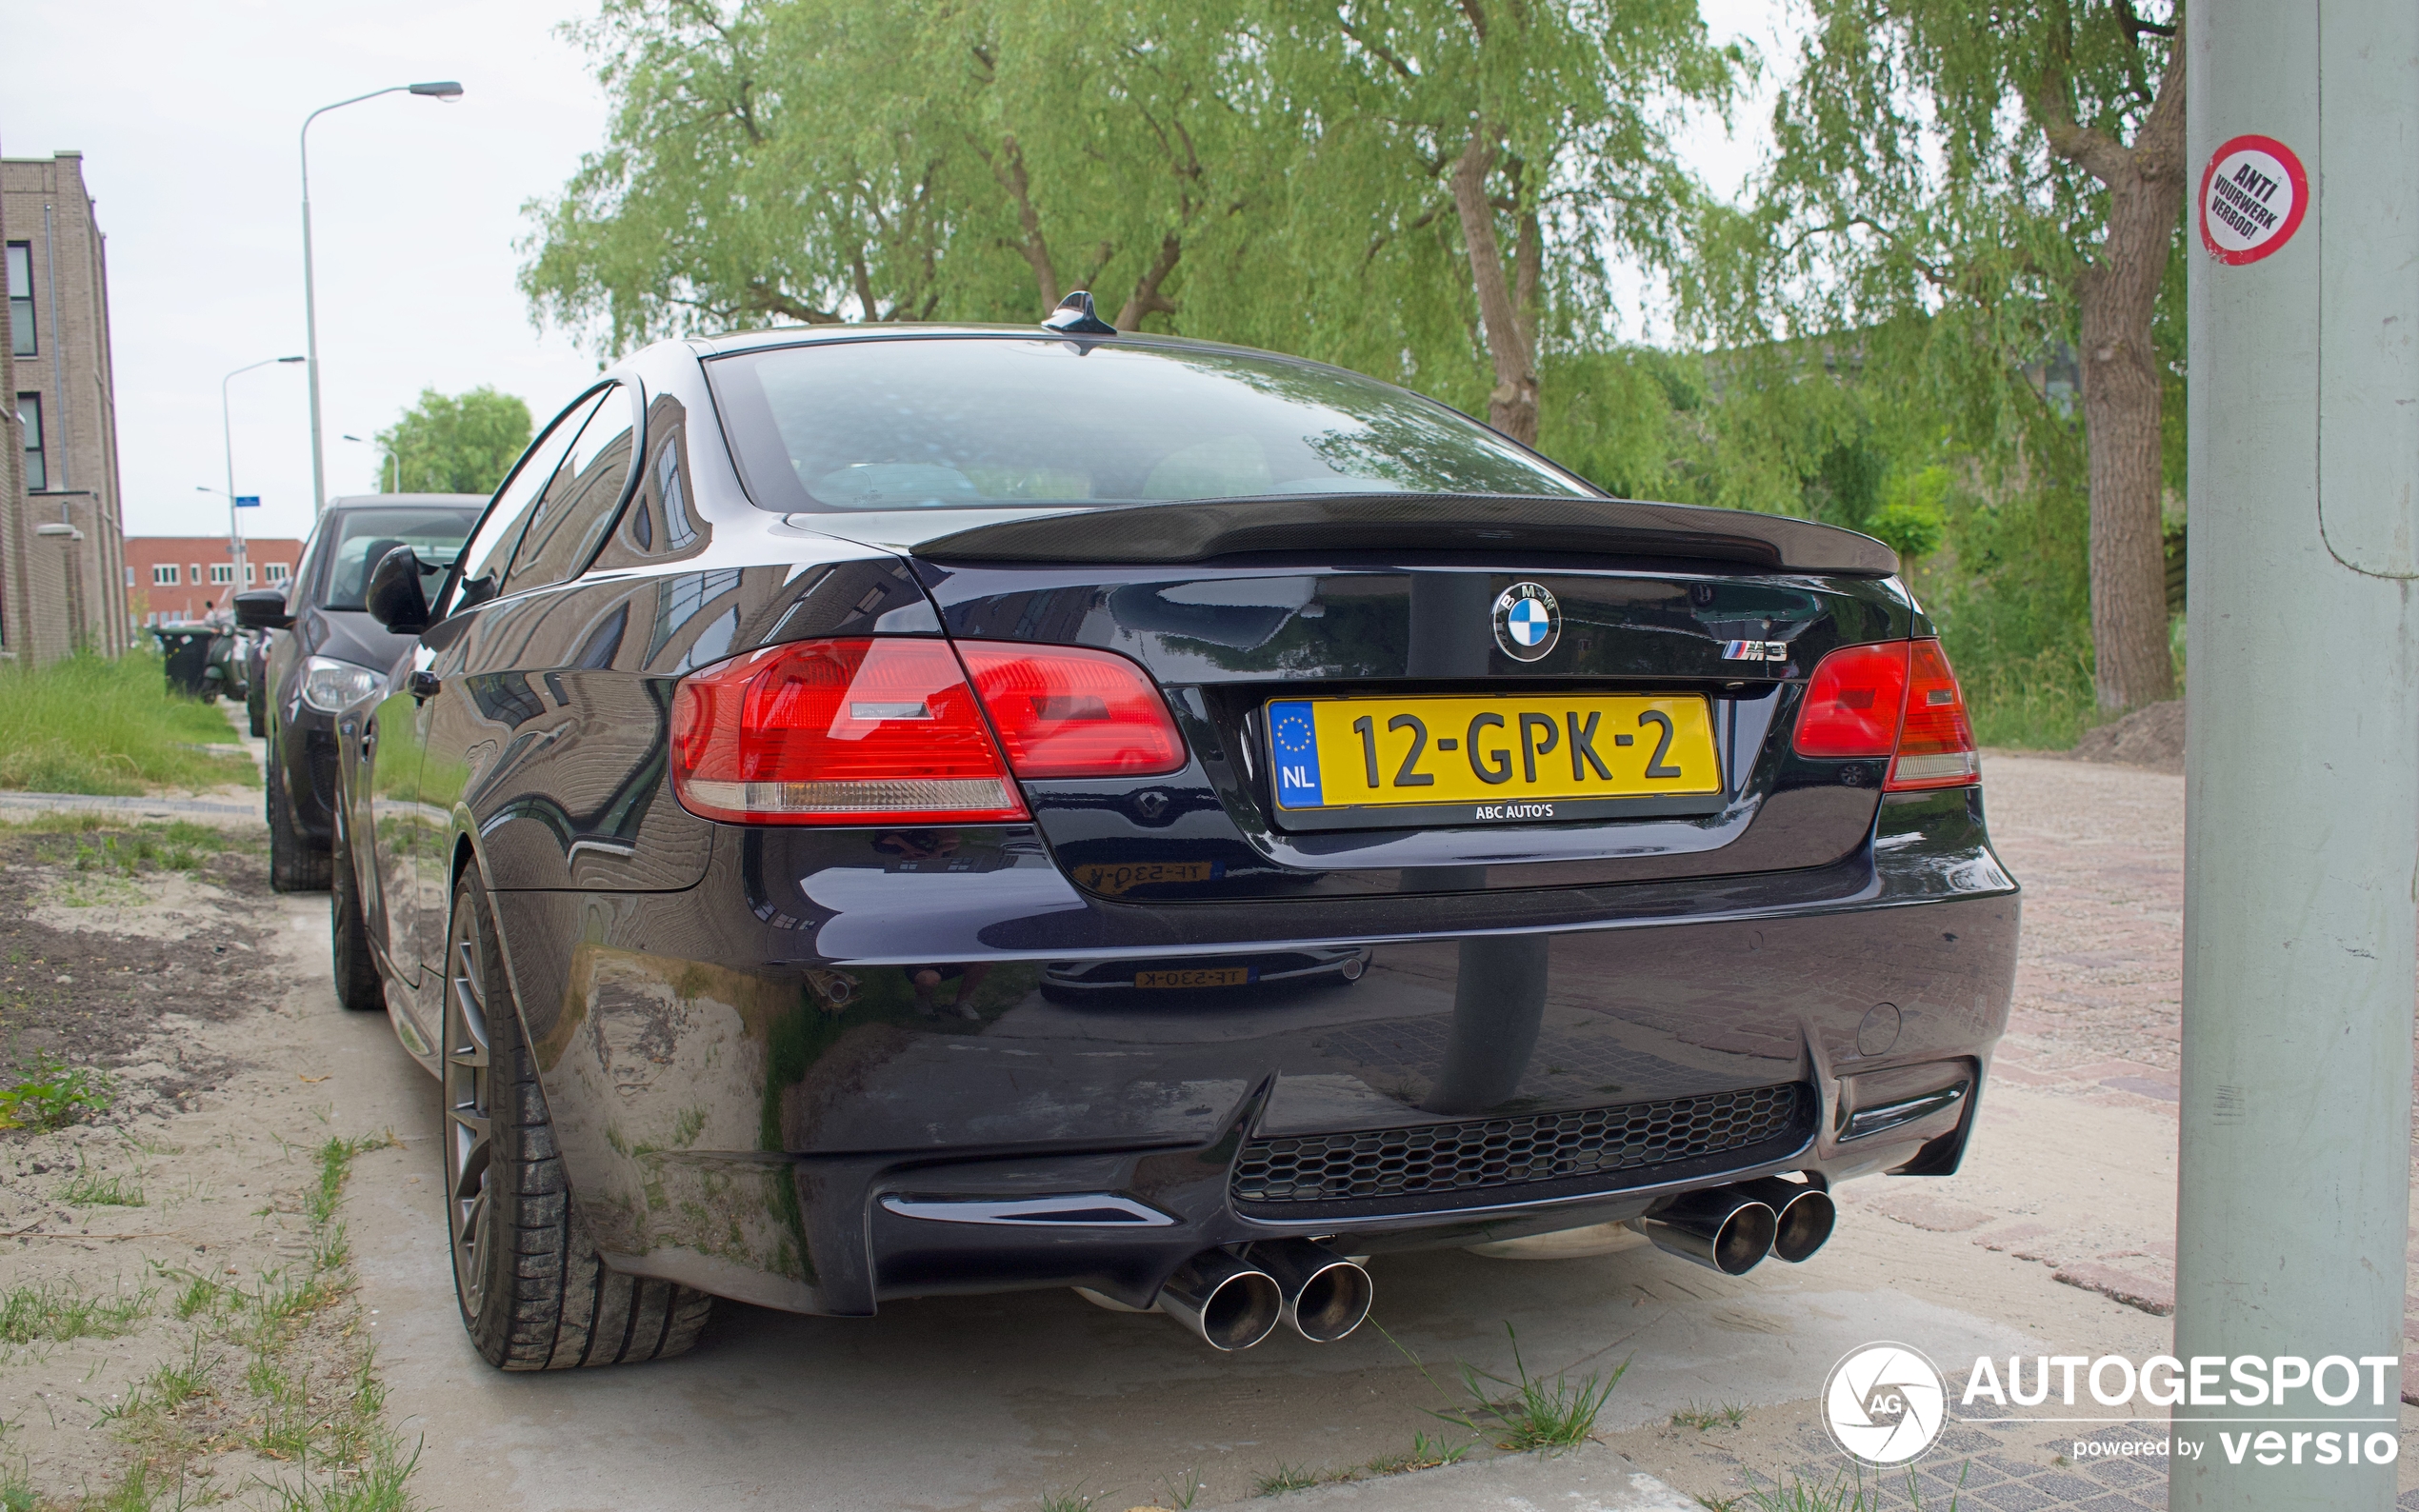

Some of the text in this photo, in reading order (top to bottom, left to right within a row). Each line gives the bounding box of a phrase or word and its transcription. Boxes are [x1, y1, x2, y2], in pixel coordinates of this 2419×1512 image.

[2213, 173, 2279, 230] VUURWERK
[2232, 163, 2279, 204] ANTI
[2210, 195, 2259, 241] VERBOD!
[1500, 585, 1555, 610] BMW
[1739, 640, 1788, 661] M3
[1352, 709, 1682, 788] 12-GPK-2
[1282, 766, 1315, 788] NL
[1475, 804, 1554, 820] ABC AUTO'S
[490, 967, 506, 1109] MICHELIN
